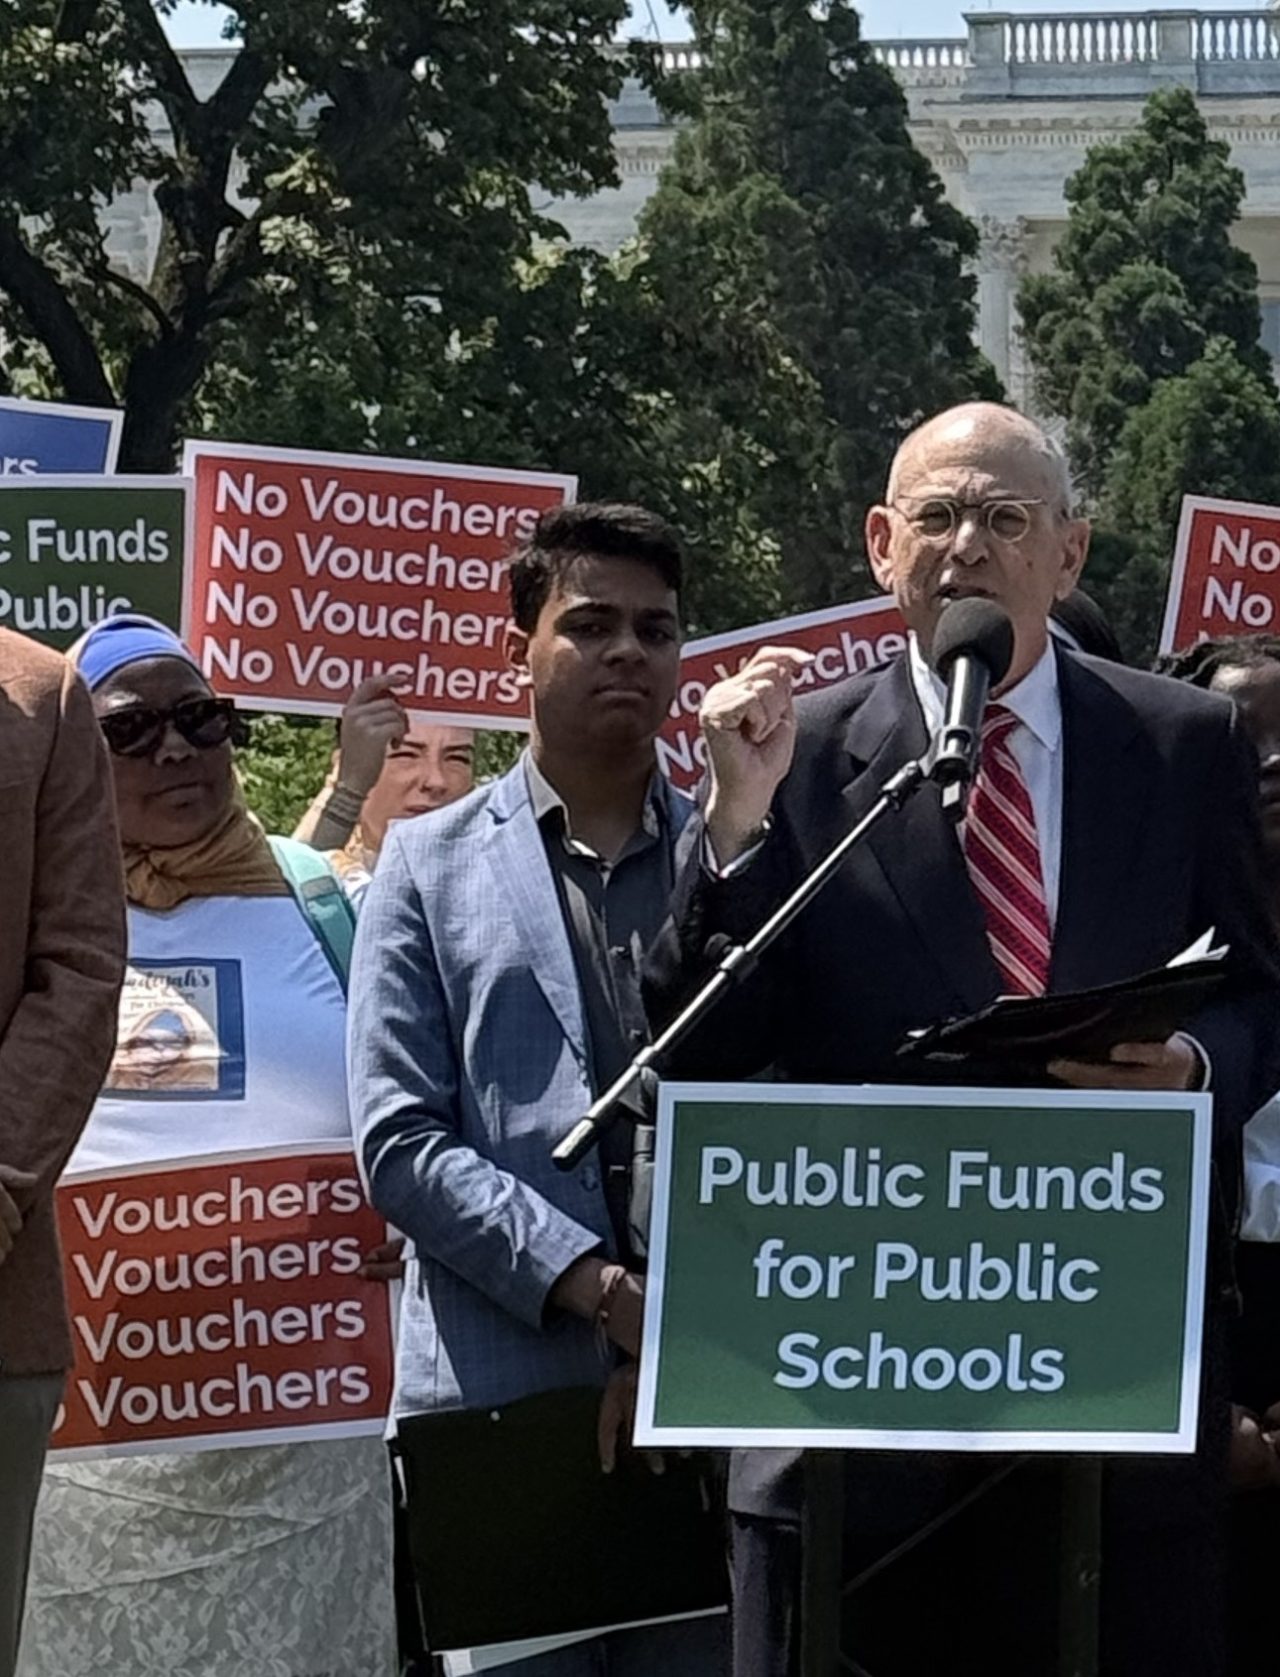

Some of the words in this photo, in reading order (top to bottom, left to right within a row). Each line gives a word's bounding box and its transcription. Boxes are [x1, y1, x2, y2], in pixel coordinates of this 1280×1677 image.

[0, 456, 39, 474] rs
[214, 470, 288, 519] No
[300, 477, 540, 541] Vouchers
[28, 518, 170, 563] Funds
[209, 525, 284, 573] No
[295, 532, 512, 593] Voucher
[204, 580, 278, 628] No
[290, 587, 515, 648] Voucher
[1202, 576, 1273, 627] No
[201, 635, 274, 684] No
[284, 641, 522, 704] Vouchers
[669, 681, 706, 718] o
[73, 1176, 361, 1240] Vouchers
[699, 1146, 926, 1208] Public
[946, 1150, 1166, 1212] Funds
[72, 1235, 362, 1300] Vouchers
[753, 1238, 856, 1299] for
[872, 1241, 1101, 1303] Public
[74, 1299, 366, 1364] Vouchers
[773, 1331, 1066, 1392] Schools
[78, 1363, 371, 1429] Vouchers
